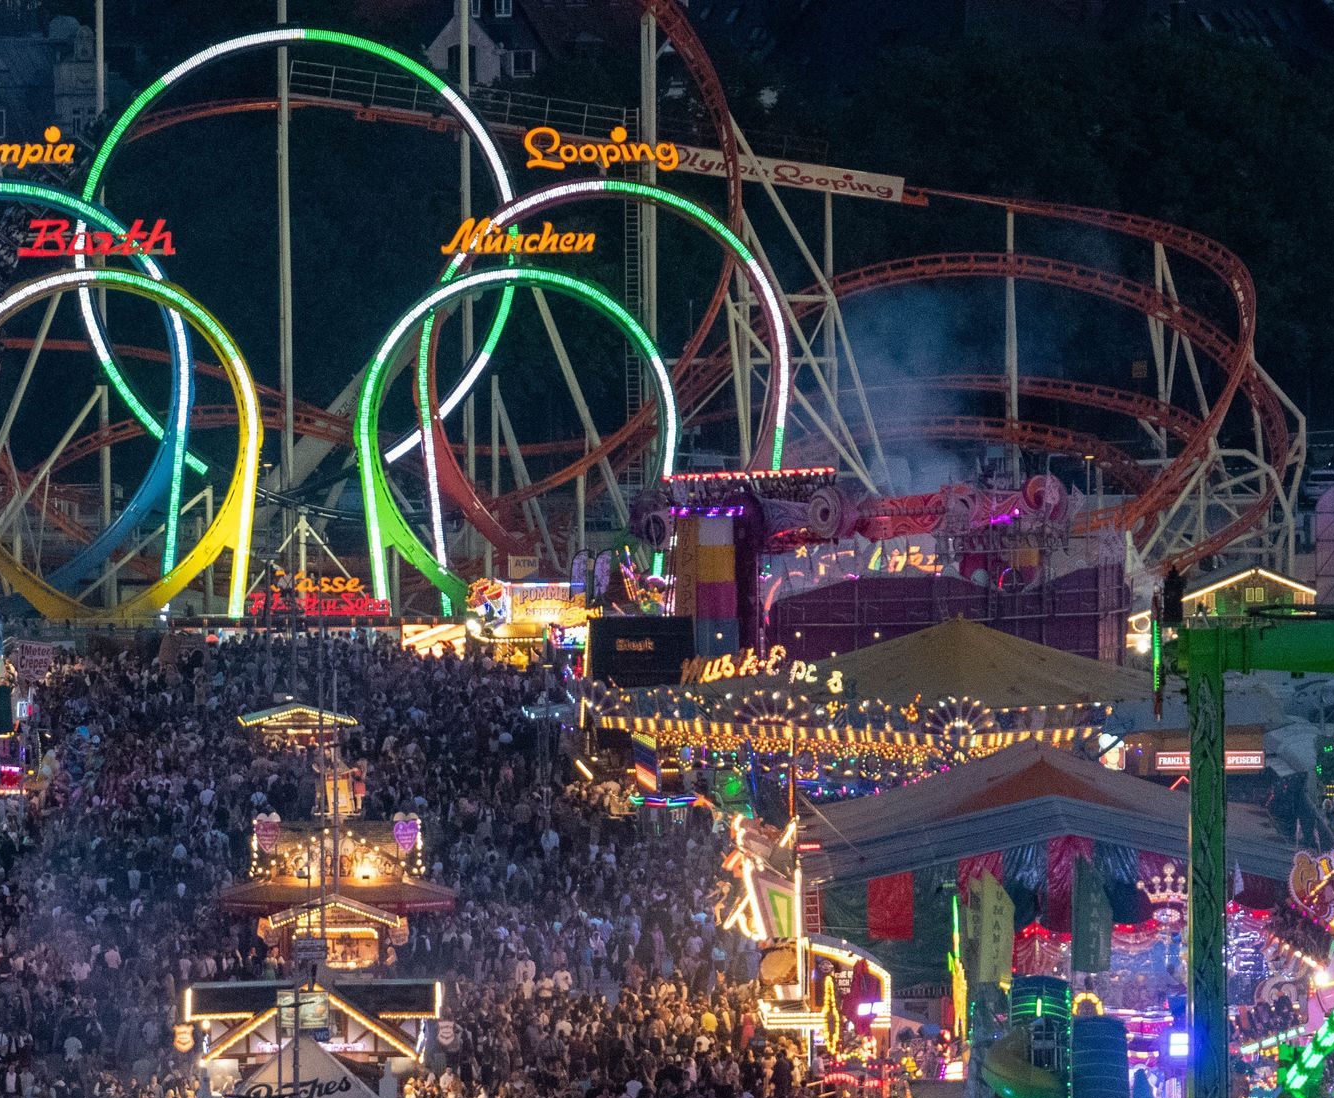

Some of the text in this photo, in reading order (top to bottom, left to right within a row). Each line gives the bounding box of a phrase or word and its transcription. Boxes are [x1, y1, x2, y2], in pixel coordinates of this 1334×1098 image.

[524, 127, 679, 170] Looping
[773, 164, 894, 199] Looping
[17, 219, 176, 257] Barth
[441, 217, 596, 254] München
